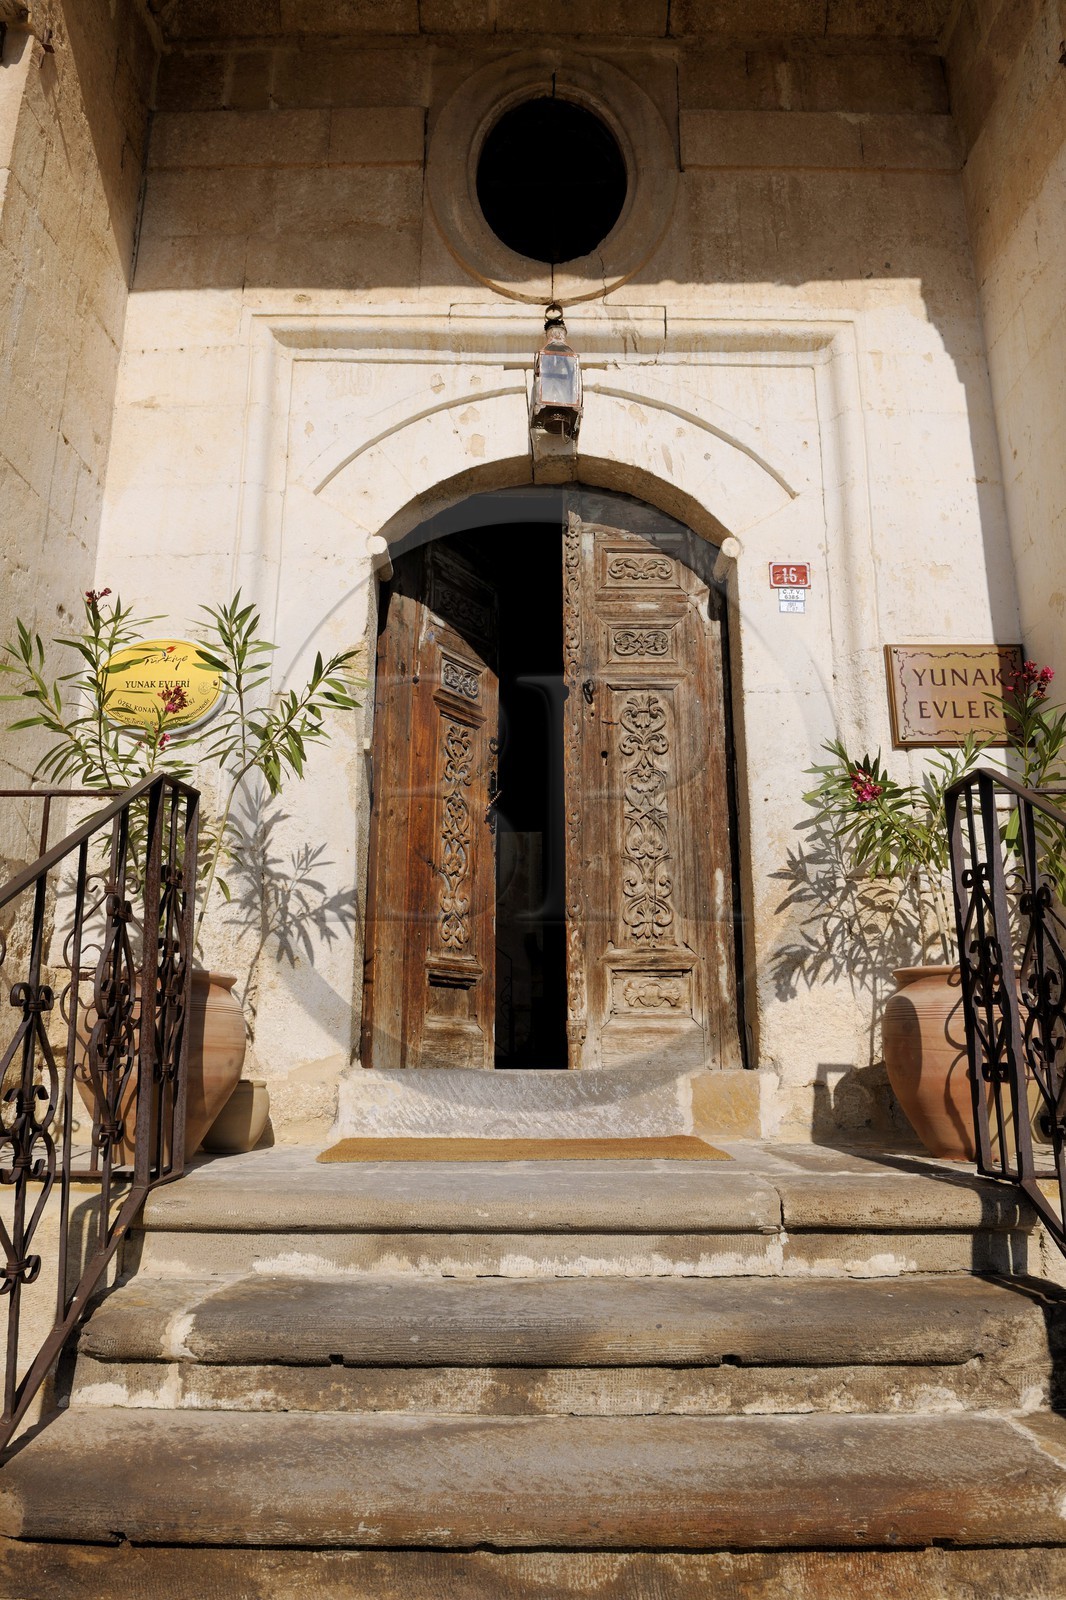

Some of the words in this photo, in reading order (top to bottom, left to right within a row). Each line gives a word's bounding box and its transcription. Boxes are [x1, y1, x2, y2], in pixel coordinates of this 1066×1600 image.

[782, 567, 797, 583] 16
[125, 680, 156, 689] YUNAK
[158, 678, 190, 688] EVLERİ
[912, 668, 1007, 686] YUNAK
